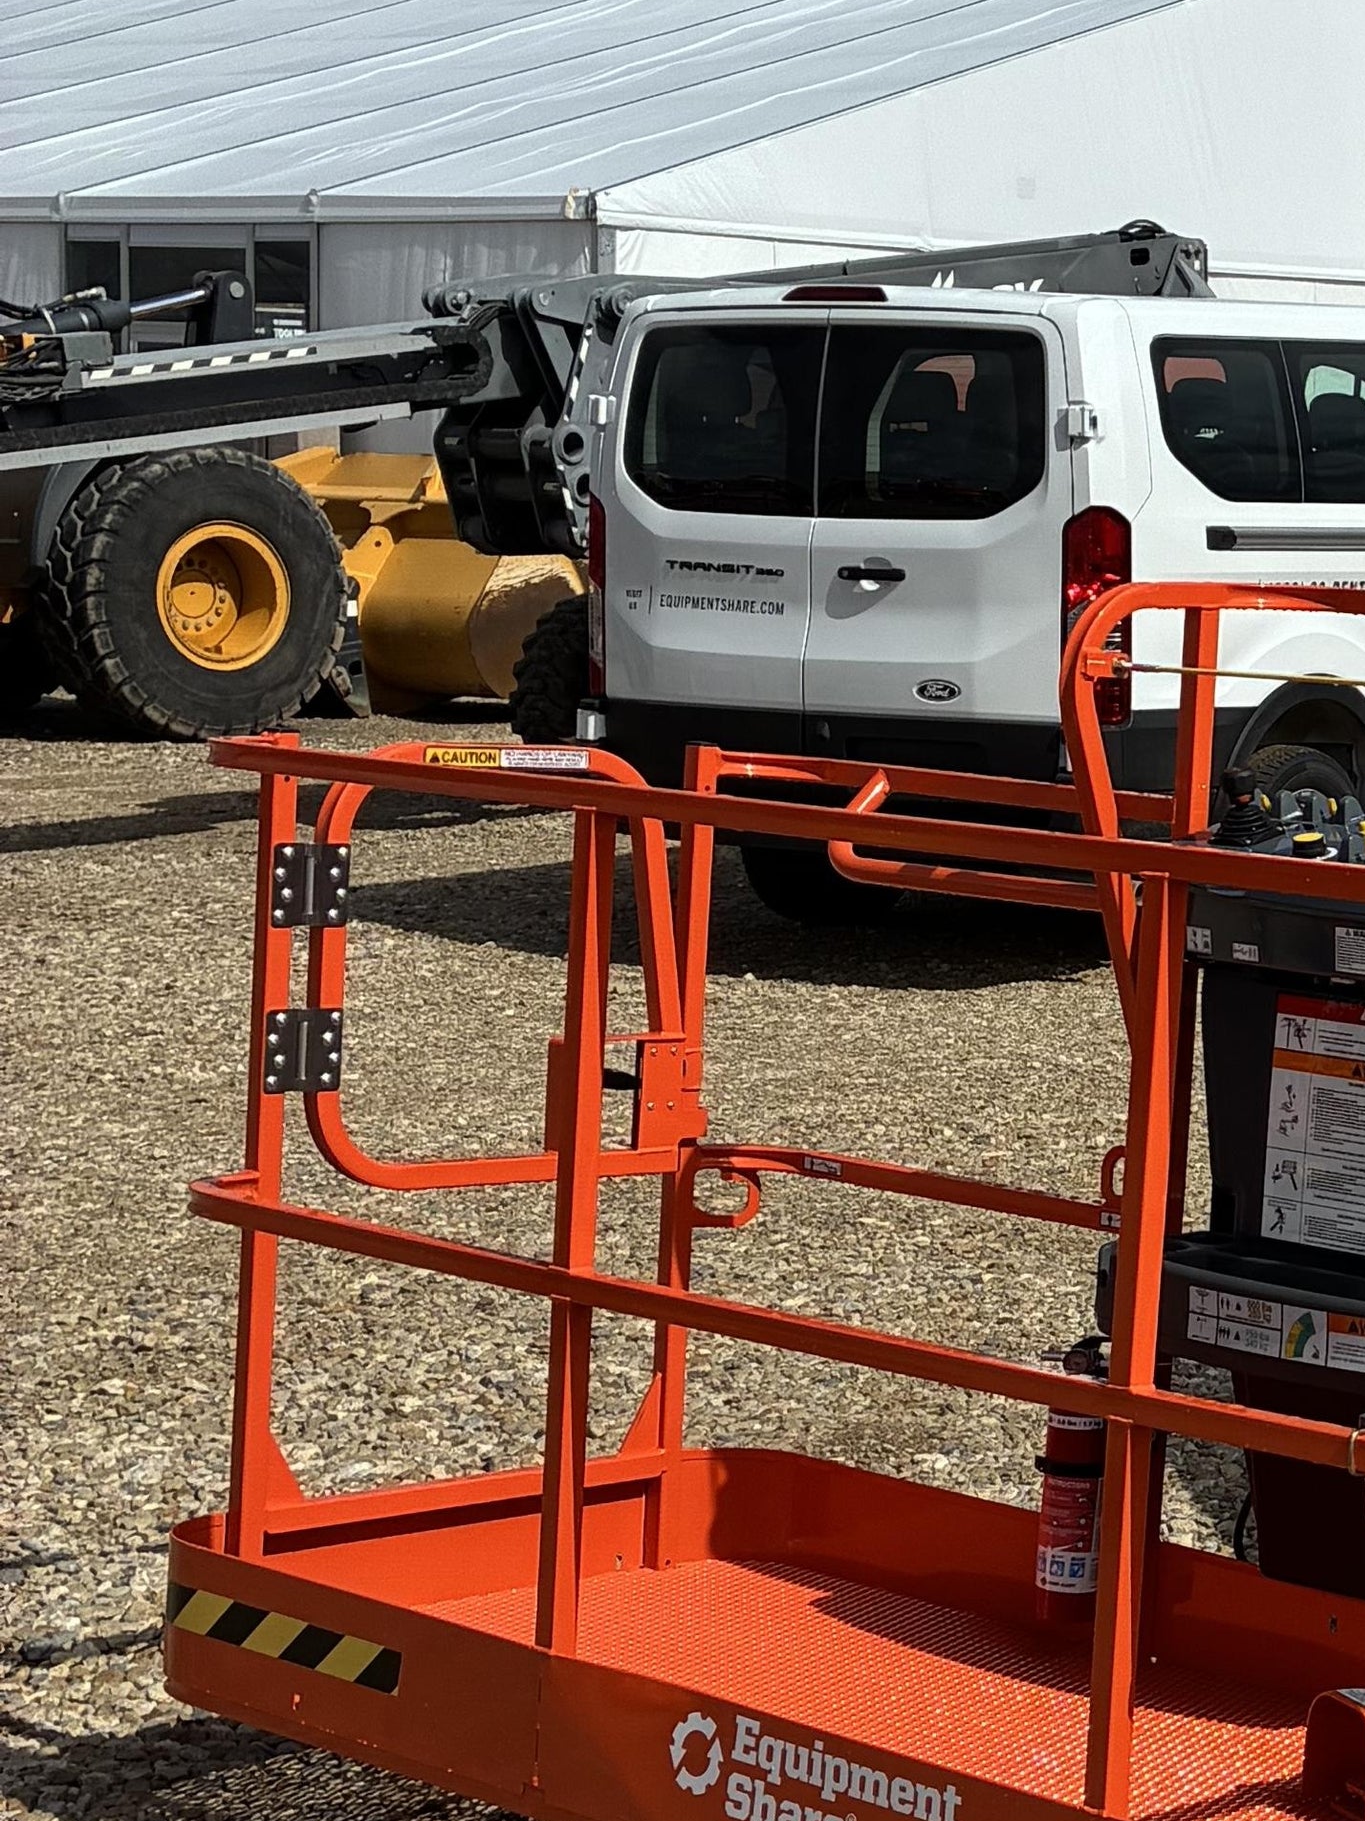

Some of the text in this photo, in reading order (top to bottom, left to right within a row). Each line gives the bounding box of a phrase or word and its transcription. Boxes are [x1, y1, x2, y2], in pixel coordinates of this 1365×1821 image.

[665, 559, 755, 575] TRANSIT
[659, 593, 785, 616] EQUIPMENTSHARE.COM
[441, 751, 497, 765] CAUTION
